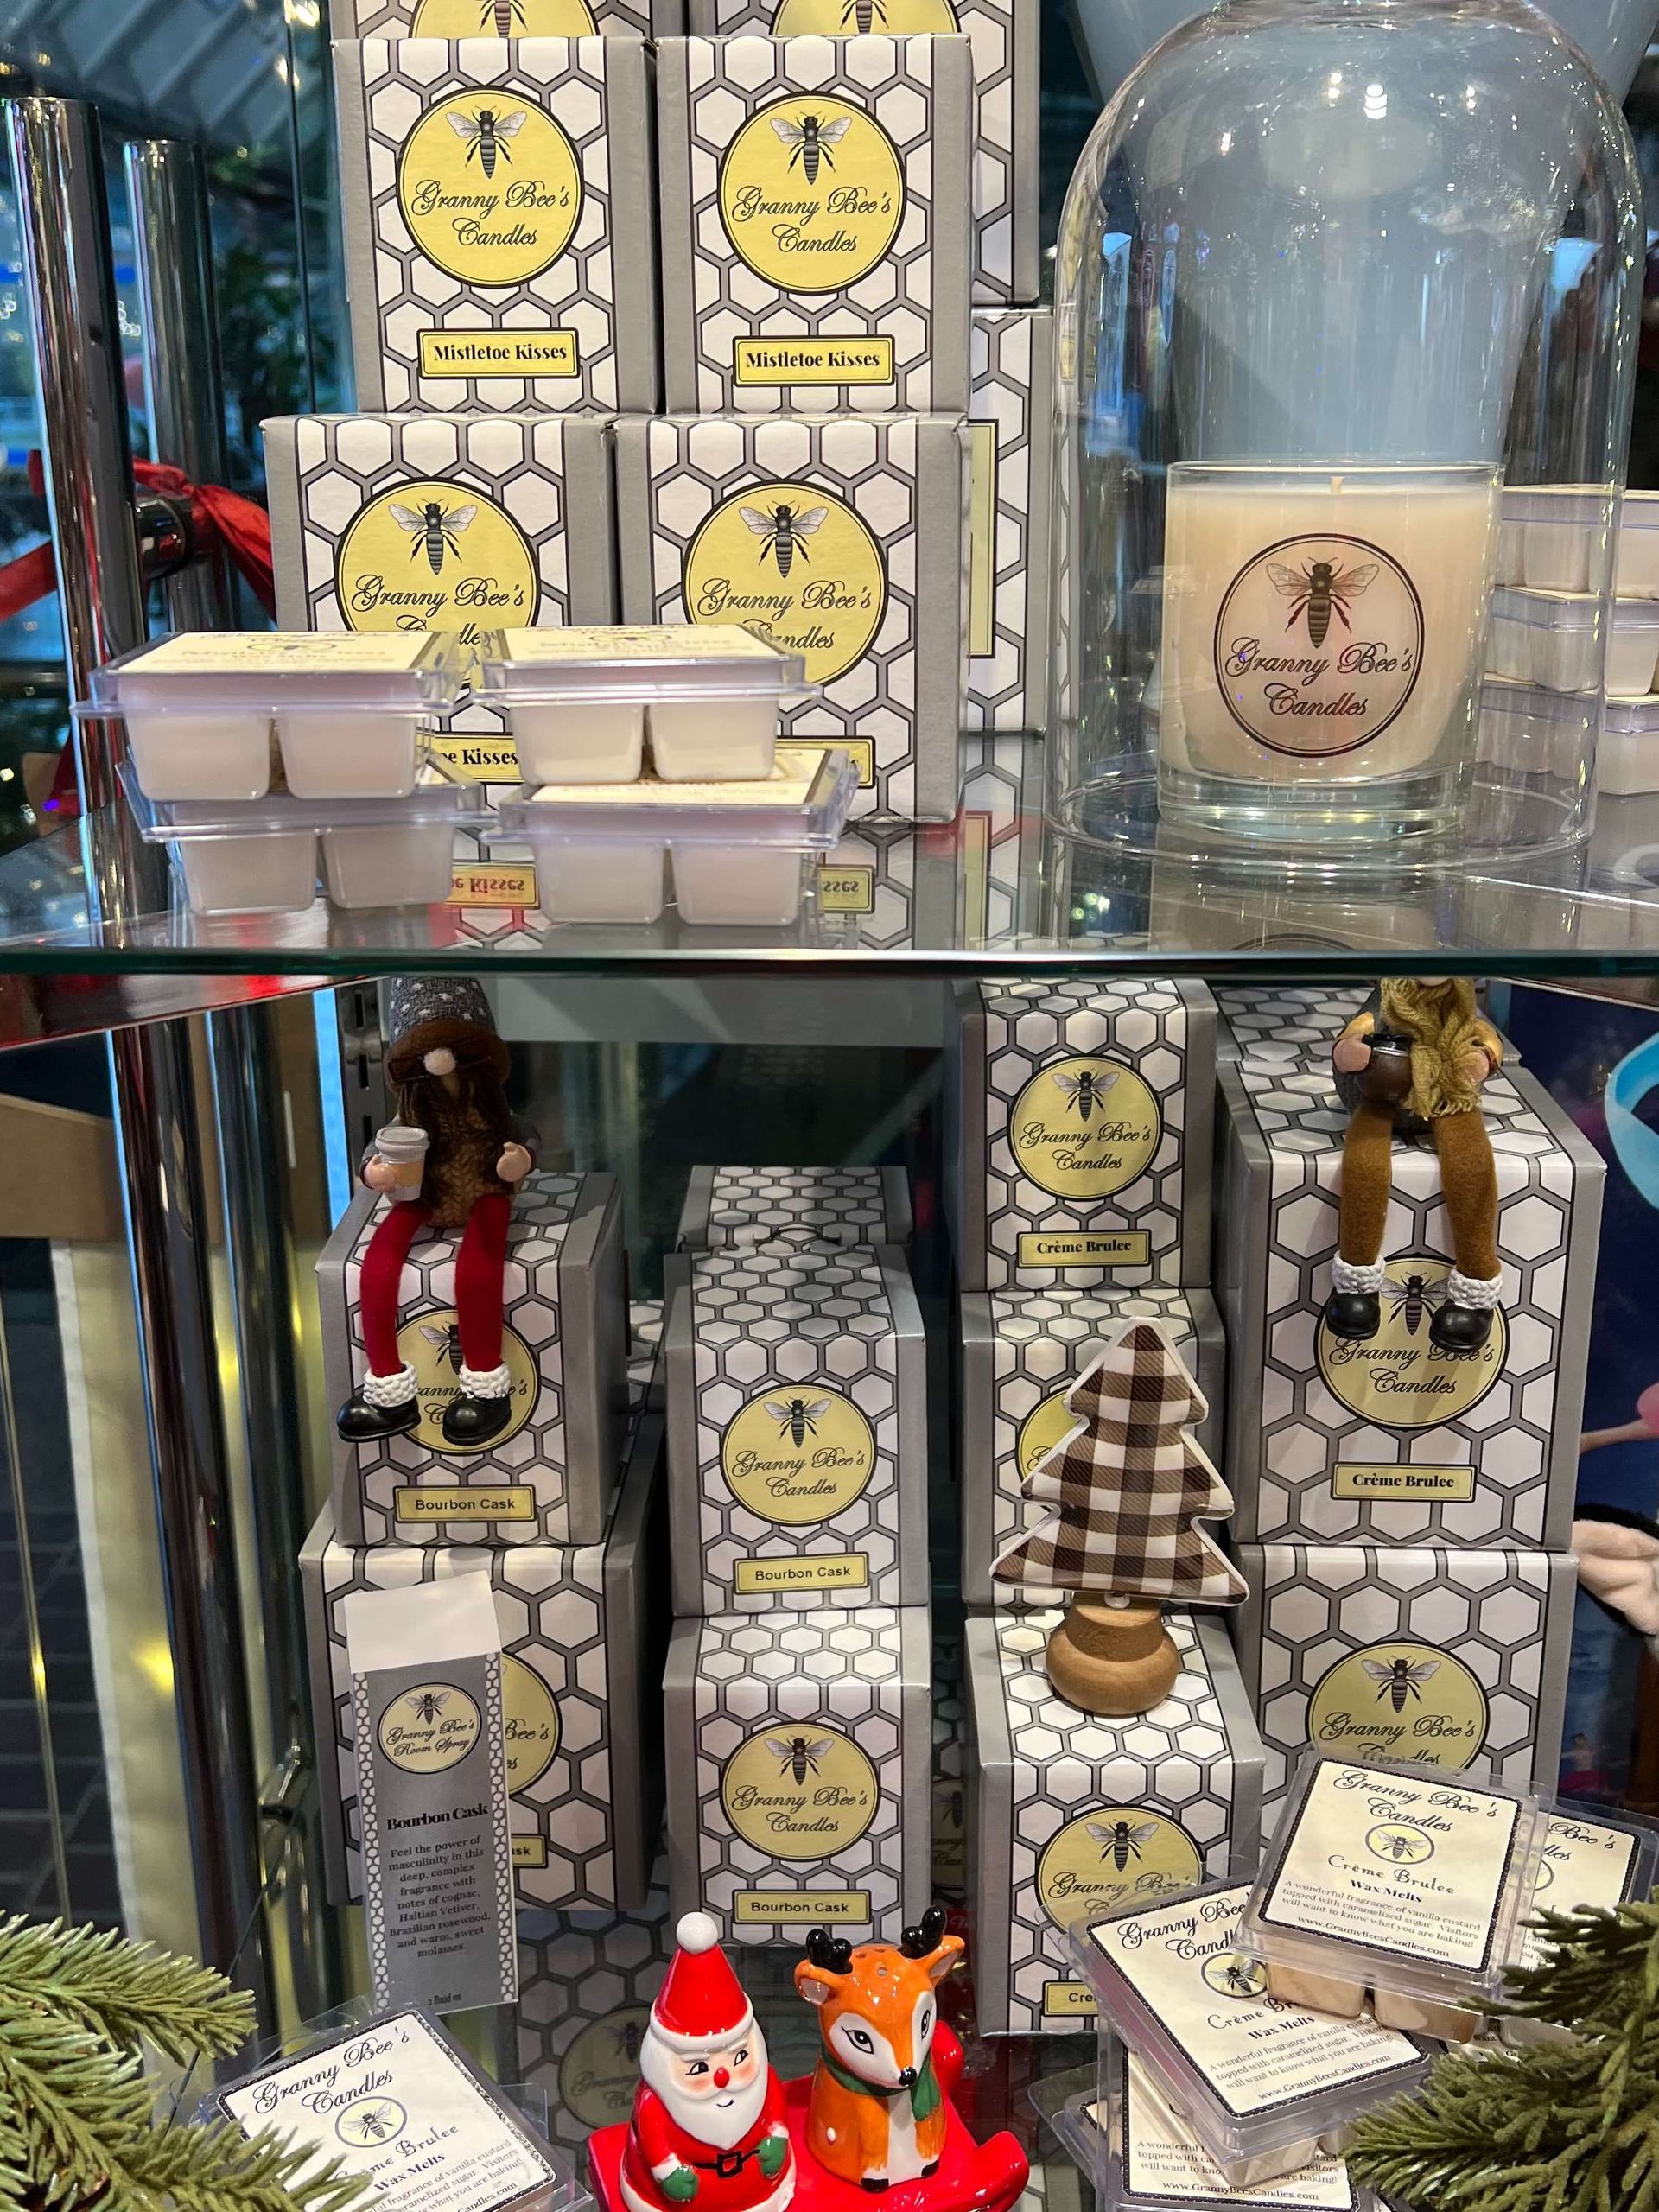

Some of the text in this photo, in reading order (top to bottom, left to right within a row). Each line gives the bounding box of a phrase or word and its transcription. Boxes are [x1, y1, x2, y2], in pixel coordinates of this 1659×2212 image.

[412, 180, 570, 226] Granny Bee's
[731, 186, 892, 226] Granny Bee's
[452, 217, 537, 250] Candles
[772, 223, 859, 254] Candles
[433, 343, 567, 362] Mistletoe Kisses
[747, 351, 880, 369] Mistletoe Kisses
[352, 574, 524, 617] Granny Bee's
[697, 578, 872, 621] Granny Bee's
[1225, 637, 1413, 686] Granny Bee's
[1264, 683, 1369, 716] Candles
[461, 747, 518, 765] Kisses
[1019, 1122, 1152, 1151] Granny Bee's
[1052, 1149, 1123, 1171] Candles
[1037, 1240, 1132, 1254] Crème Brulee
[1329, 1336, 1421, 1371] Granny
[1370, 1368, 1457, 1395] Candles
[732, 1446, 865, 1478] Granny Bee's
[766, 1477, 837, 1497] Candles
[1352, 1472, 1454, 1488] Crème Brulee
[415, 1498, 515, 1510] Bourbon Cask
[755, 1566, 851, 1580] Bourbon Cask
[386, 1719, 474, 1745] Granny Bee's
[1319, 1712, 1477, 1745] Granny Bee's
[394, 1737, 470, 1757] Room Spray
[732, 1784, 868, 1814] Granny Bee's
[1333, 1770, 1498, 1818] Granny Bee's
[387, 1803, 488, 1830] Bourbon Cask
[766, 1812, 840, 1833] Candles
[1367, 1796, 1454, 1833] Candles
[391, 1834, 481, 1858] Feel the power of
[1548, 1821, 1616, 1849] Bee's
[388, 1848, 484, 1871] masculinity in this
[431, 1864, 474, 1878] complex
[400, 1876, 475, 1897] fragrance with
[1048, 1872, 1128, 1900] Granny
[1327, 1854, 1456, 1894] Crème Brulee
[397, 1899, 426, 1910] notes
[429, 1895, 441, 1905] of
[1351, 1879, 1423, 1903] Wax Melts
[399, 1910, 437, 1923] Haitian
[752, 1902, 849, 1912] Bourbon Cask
[1282, 1888, 1317, 1904] topped
[1319, 1895, 1340, 1907] with
[1342, 1902, 1402, 1922] caramelized
[1440, 1924, 1479, 1940] Visitors
[1282, 1897, 1300, 1908] will
[1302, 1902, 1326, 1914] want
[1329, 1907, 1338, 1916] to
[1340, 1910, 1368, 1923] know
[1370, 1916, 1395, 1929] what
[1396, 1923, 1415, 1936] you
[1417, 1928, 1434, 1940] are
[1295, 1883, 1344, 1899] wonderful
[1346, 1893, 1394, 1911] fragrance
[1395, 1904, 1407, 1914] of
[1408, 1908, 1440, 1923] vanilla
[1442, 1916, 1481, 1932] custard
[390, 1923, 435, 1936] Brazilian
[397, 1937, 416, 1948] and
[454, 1927, 484, 1936] sweet
[1117, 1916, 1198, 1950] Granny
[1297, 1916, 1450, 1957] www.GrannyBeesCandles.com
[1166, 1929, 1234, 1960] Candl
[1207, 2008, 1264, 2031] Crème
[1248, 2014, 1315, 2040] Wax Melts
[1218, 2050, 1263, 2069] wonderful
[1263, 2037, 1306, 2056] fragrance
[1307, 2032, 1317, 2043] of
[1318, 2024, 1345, 2039] vanilla
[252, 2026, 410, 2115] Granny Bee's
[1216, 2065, 1249, 2082] topped
[1249, 2059, 1270, 2072] with
[1271, 2043, 1324, 2066] caramelized
[1226, 2076, 1244, 2089] will
[1245, 2072, 1268, 2086] want
[1270, 2069, 1278, 2078] to
[1280, 2060, 1305, 2075] know
[1306, 2053, 1328, 2069] what
[1328, 2049, 1346, 2061] you
[1346, 2044, 1362, 2055] are
[1258, 2054, 1392, 2101] www.GrannyBeesCandles.com
[301, 2070, 393, 2115] Candles
[395, 2125, 460, 2158] Brulee
[1145, 2140, 1198, 2152] wonderful
[480, 2148, 520, 2171] Visitors
[1137, 2151, 1173, 2161] topped
[1175, 2152, 1198, 2163] with
[1141, 2162, 1222, 2175] will want to kno
[373, 2174, 406, 2192] Wax
[407, 2153, 447, 2174] Melts
[387, 2181, 434, 2207] fragrance
[435, 2171, 446, 2183] of
[445, 2158, 477, 2177] vanilla
[476, 2139, 512, 2162] custard
[430, 2194, 454, 2210] what
[454, 2186, 473, 2200] you
[474, 2176, 489, 2189] are
[1162, 2181, 1319, 2201] www.GrannyBeesCandles.com
